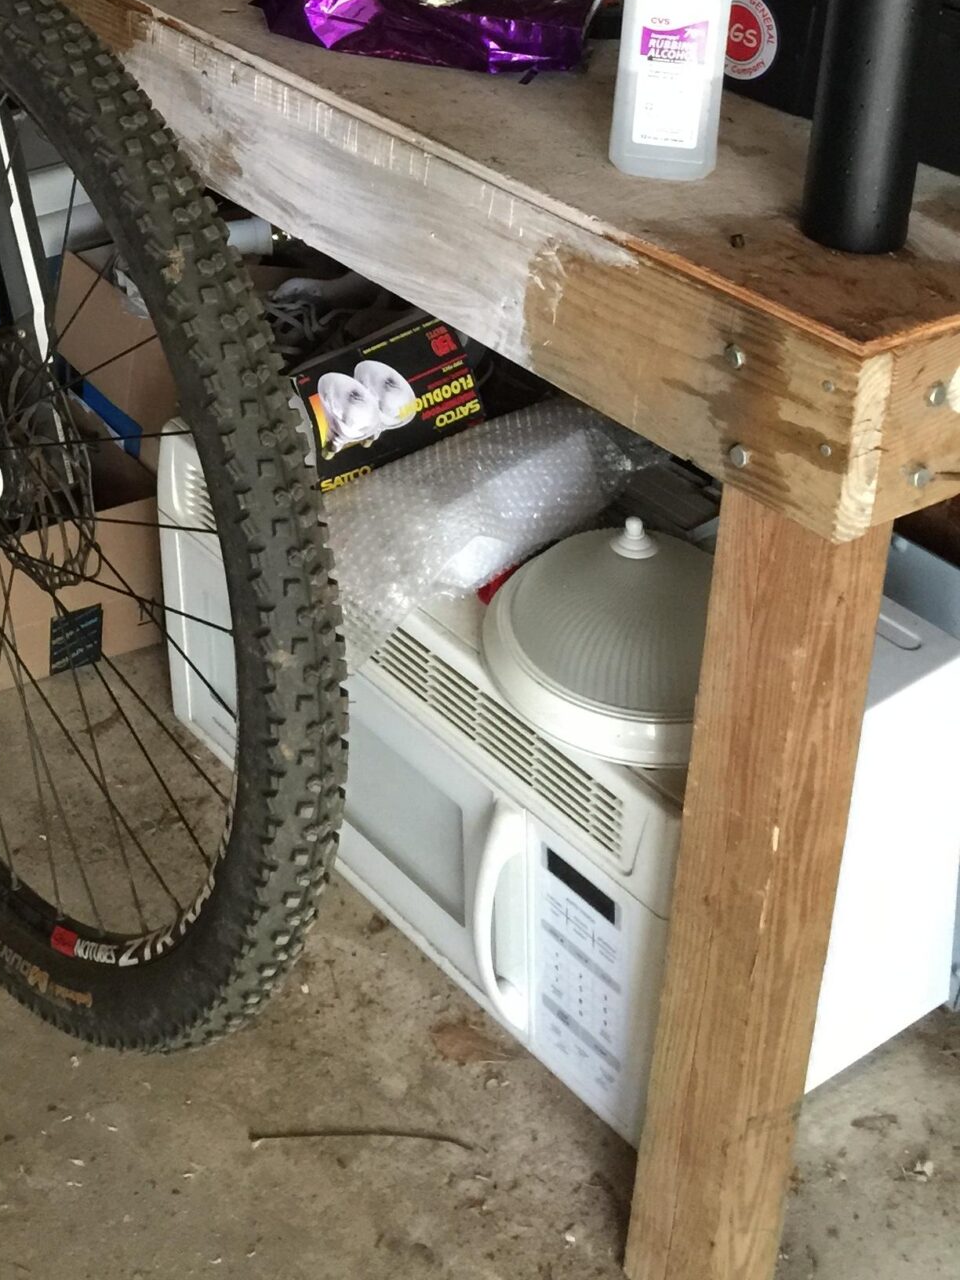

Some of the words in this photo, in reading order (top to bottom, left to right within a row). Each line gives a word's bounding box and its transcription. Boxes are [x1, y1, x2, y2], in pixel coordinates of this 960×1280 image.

[650, 17, 671, 26] CVS
[648, 39, 698, 52] RUBBIN
[729, 23, 758, 49] GS
[648, 48, 697, 63] ALCOH
[731, 60, 766, 77] Company
[435, 399, 481, 428] SATCO
[320, 465, 372, 493] SATCO
[74, 937, 117, 965] NOTUBES
